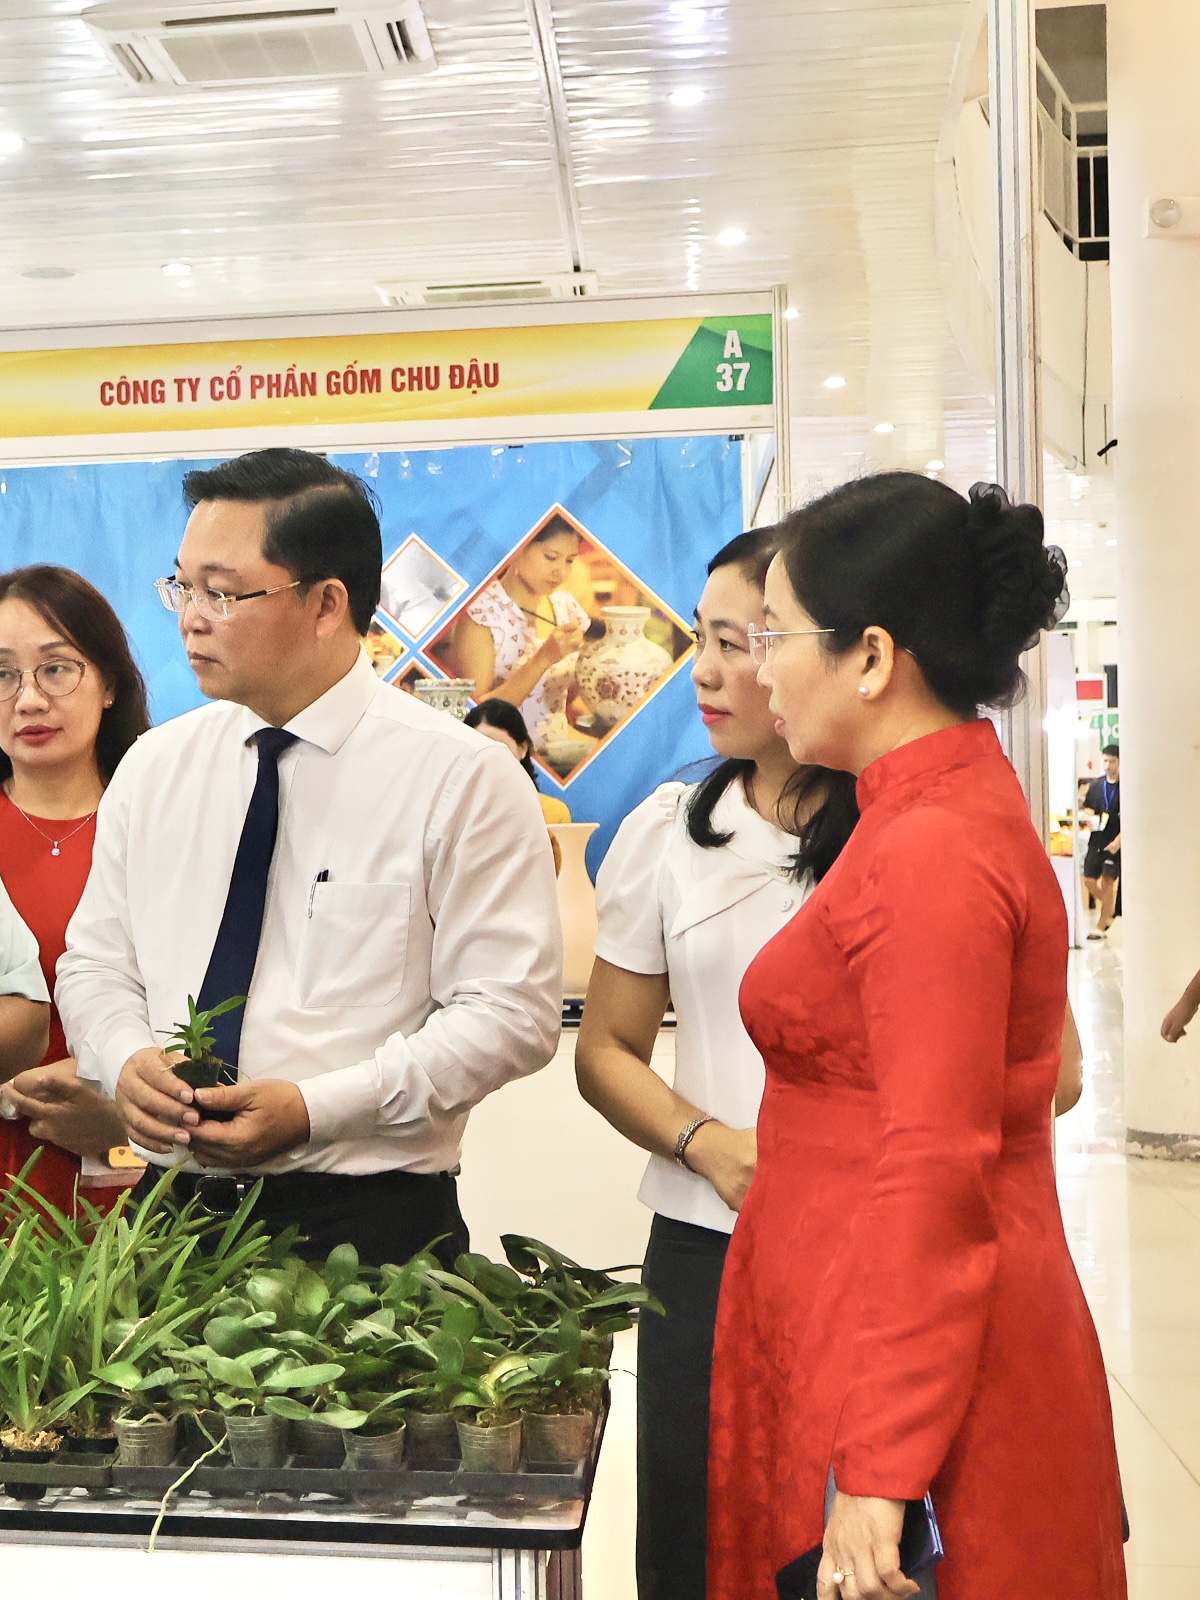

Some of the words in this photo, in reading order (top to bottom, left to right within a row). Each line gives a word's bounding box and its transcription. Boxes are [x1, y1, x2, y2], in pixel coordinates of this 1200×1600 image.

[723, 330, 743, 358] A
[100, 375, 166, 406] CÔNG
[174, 376, 201, 403] TY
[210, 365, 242, 401] CỔ
[250, 363, 318, 399] PHẦN
[326, 360, 382, 396] GỐM
[390, 365, 440, 392] CHU
[448, 358, 500, 395] ĐẬU
[716, 362, 751, 392] 37
